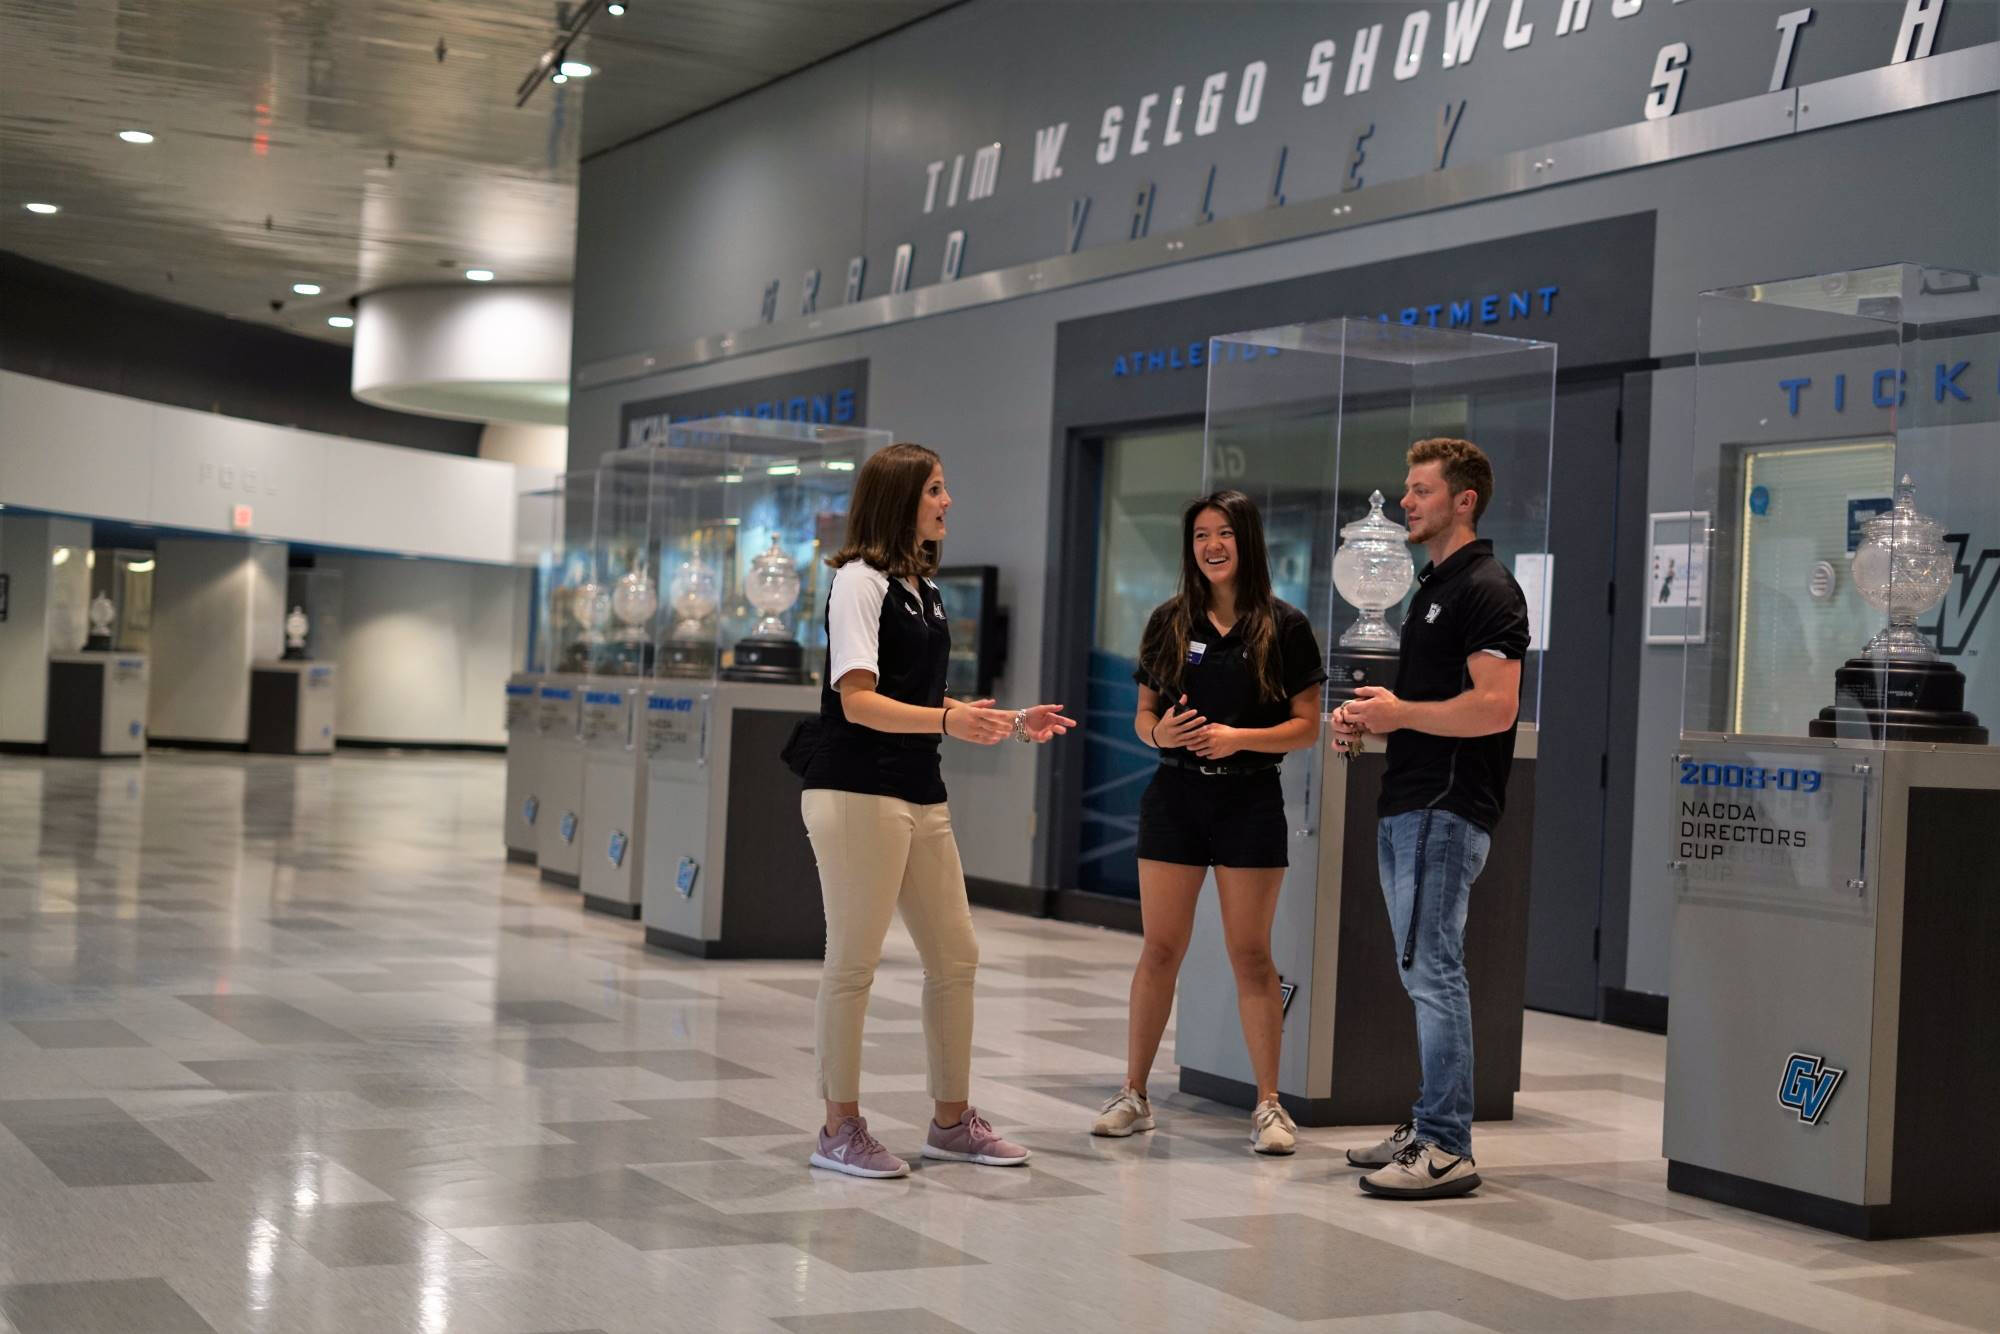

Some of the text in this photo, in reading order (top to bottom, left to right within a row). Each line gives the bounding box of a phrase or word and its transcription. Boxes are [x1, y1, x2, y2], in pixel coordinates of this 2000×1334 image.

[923, 0, 1692, 214] TIM W. SELGO SHOWC
[1068, 99, 1467, 255] VALLEY
[1353, 285, 1559, 331] ARTMENT
[1778, 358, 2000, 417] TICK
[1679, 762, 1823, 794] 2008-09
[1682, 800, 1757, 822] NACDA
[1680, 842, 1724, 860] CUP
[1681, 821, 1807, 848] DIRECTORS
[1777, 1052, 1845, 1126] GV
